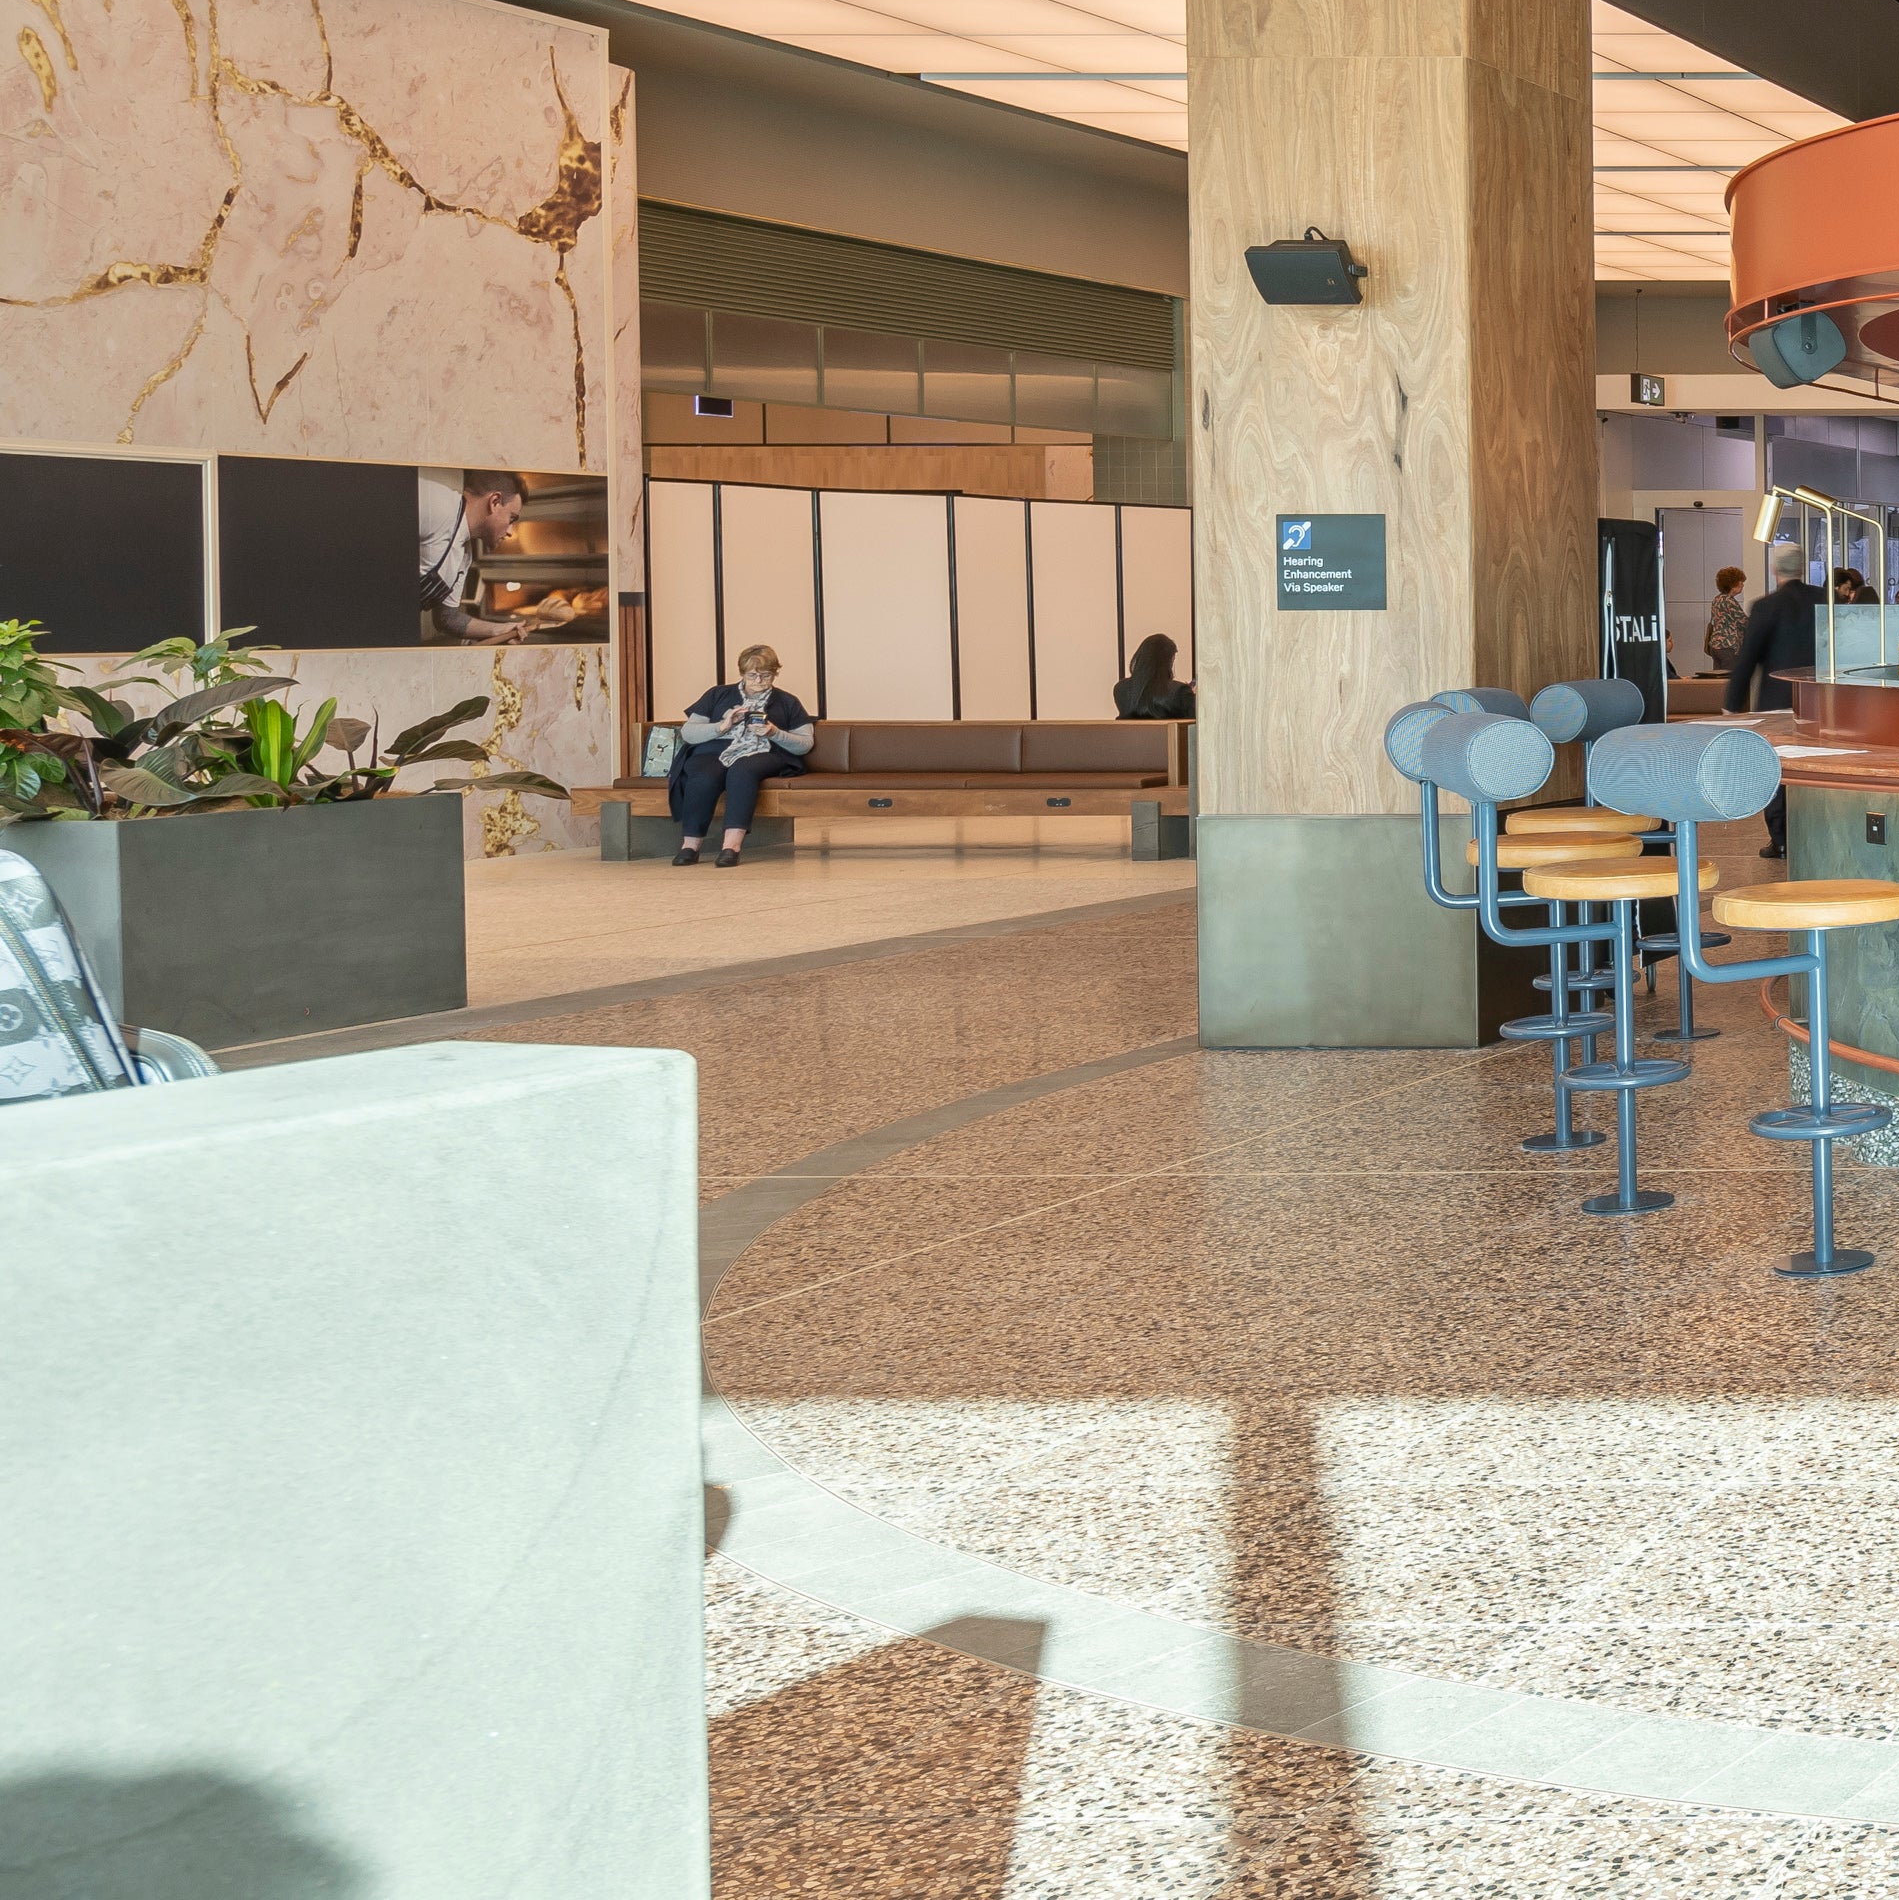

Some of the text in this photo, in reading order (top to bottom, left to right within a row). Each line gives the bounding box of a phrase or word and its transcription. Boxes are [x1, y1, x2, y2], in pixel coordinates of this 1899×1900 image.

[1283, 556, 1324, 567] Hearing
[1283, 569, 1352, 579] Enhancement
[1283, 582, 1344, 593] Via Speaker
